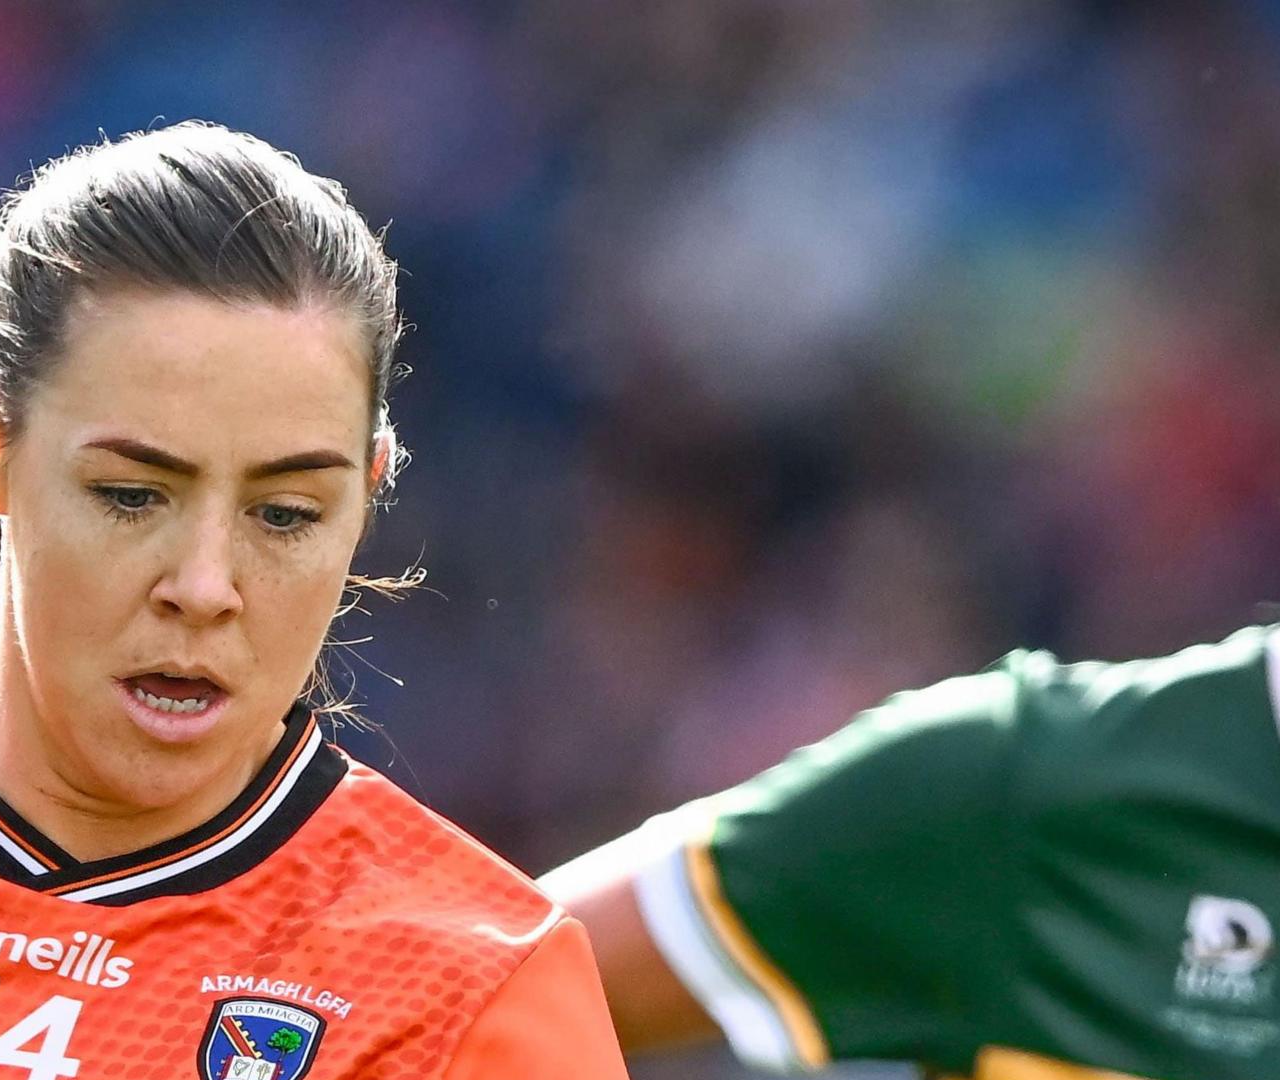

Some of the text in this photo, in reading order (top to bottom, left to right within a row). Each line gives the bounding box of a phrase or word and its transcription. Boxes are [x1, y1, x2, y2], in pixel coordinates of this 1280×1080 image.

[200, 975, 353, 1020] ARMAGH LGFA
[226, 1005, 255, 1014] ARD
